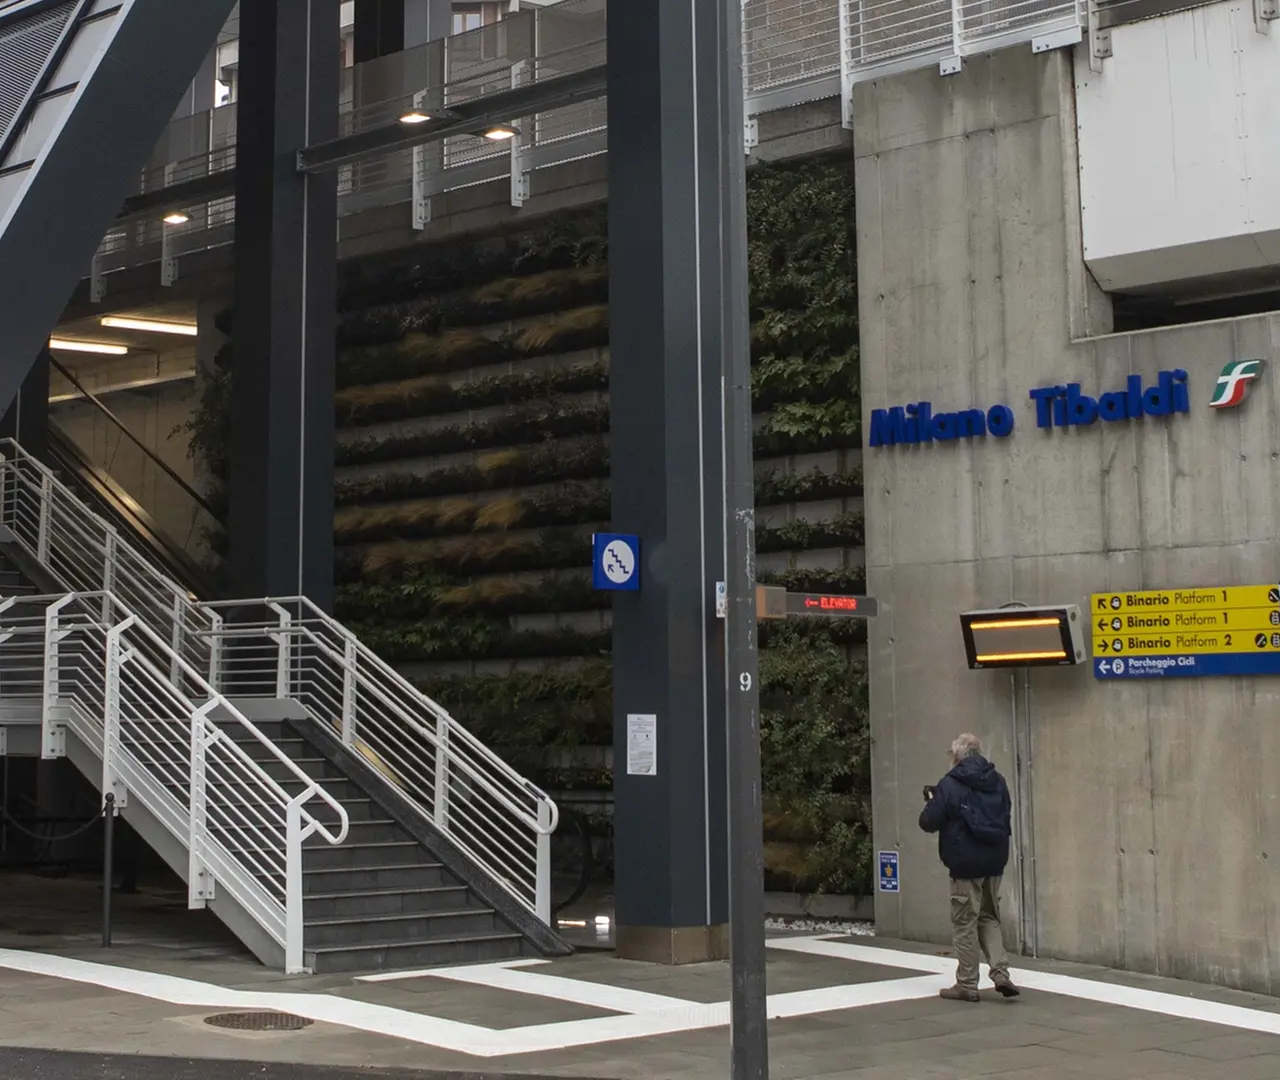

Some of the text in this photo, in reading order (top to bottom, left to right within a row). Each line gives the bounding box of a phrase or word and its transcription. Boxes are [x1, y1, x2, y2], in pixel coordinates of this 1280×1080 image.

[869, 368, 1190, 447] Milano Tibaldi
[820, 597, 857, 610] ELEVATOR
[1126, 590, 1227, 606] Binario Platform 1
[1127, 612, 1228, 628] Binario Platform 1
[1128, 634, 1232, 649] Binario Platform 2
[1128, 657, 1176, 669] Parcheggio
[739, 672, 752, 691] 9
